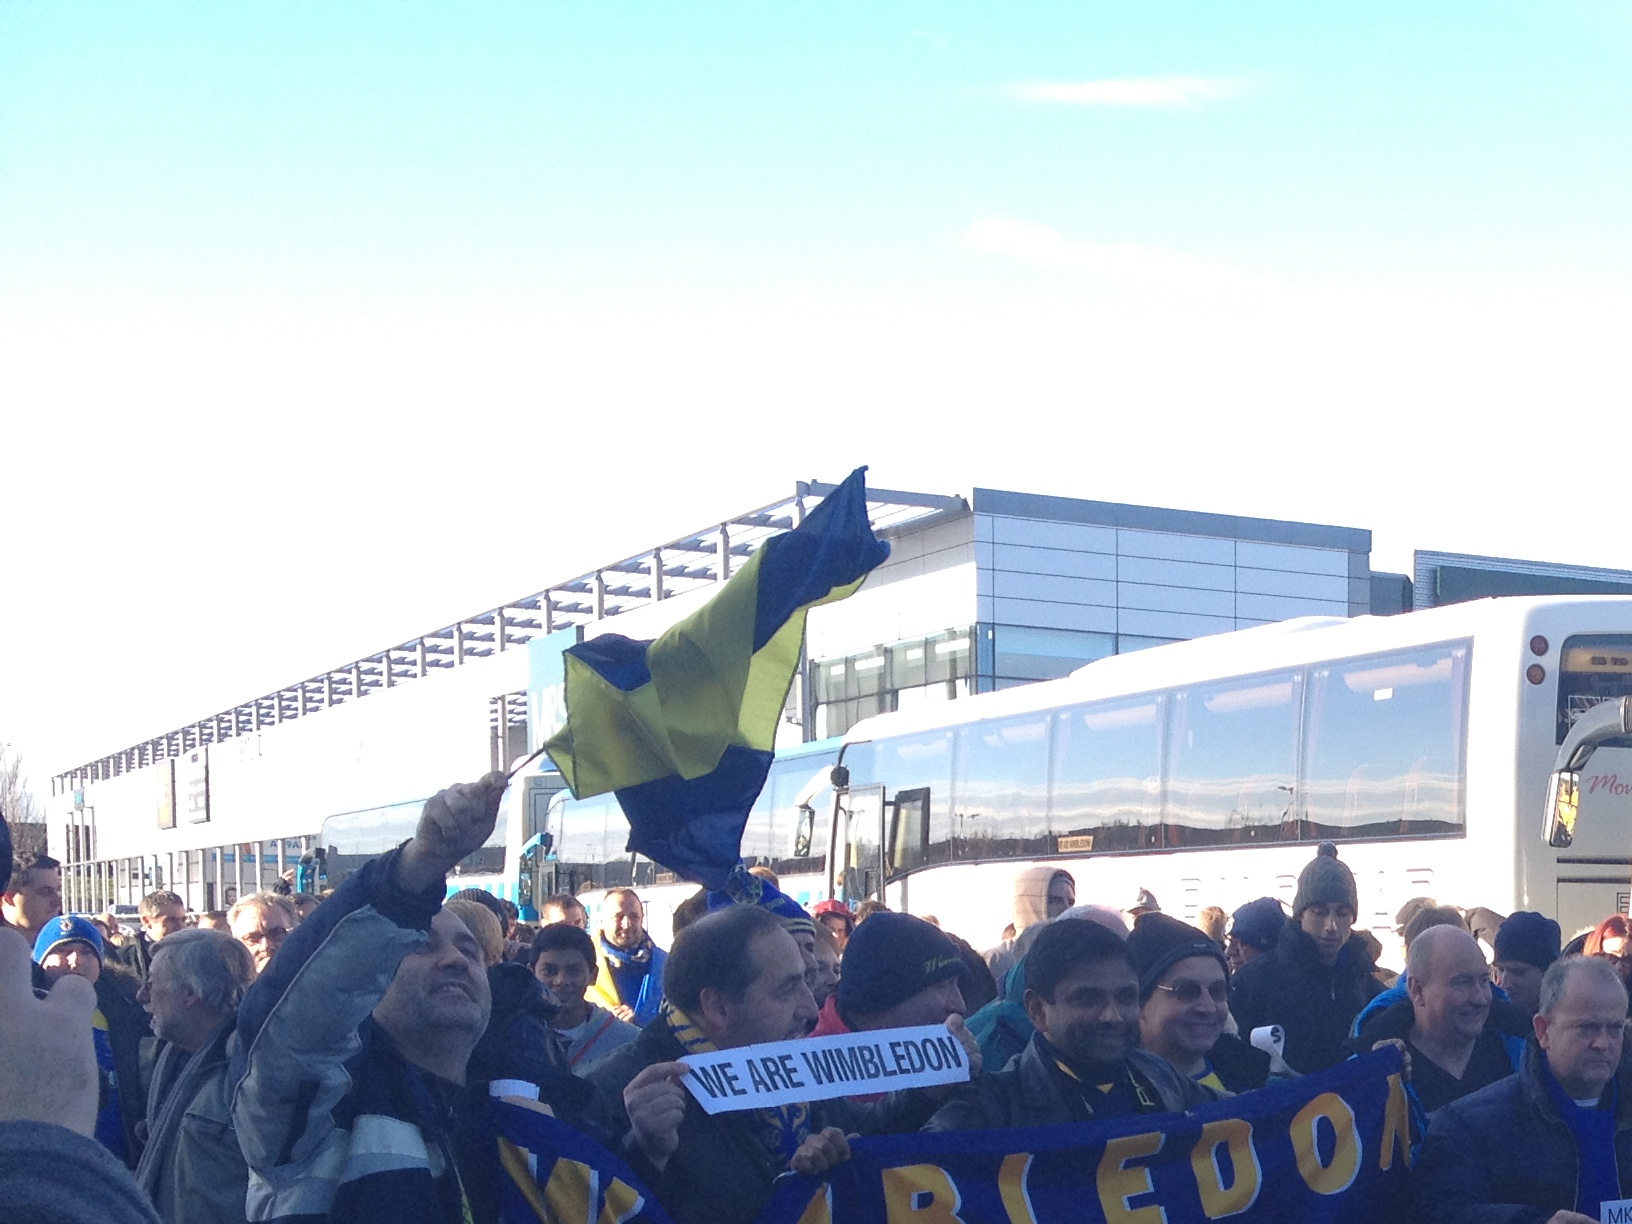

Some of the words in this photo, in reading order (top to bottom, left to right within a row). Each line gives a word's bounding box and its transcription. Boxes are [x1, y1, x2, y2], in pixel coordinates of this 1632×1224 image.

[689, 1062, 747, 1099] WE
[746, 1054, 804, 1093] ARE
[800, 1036, 963, 1085] WIMBLEDON
